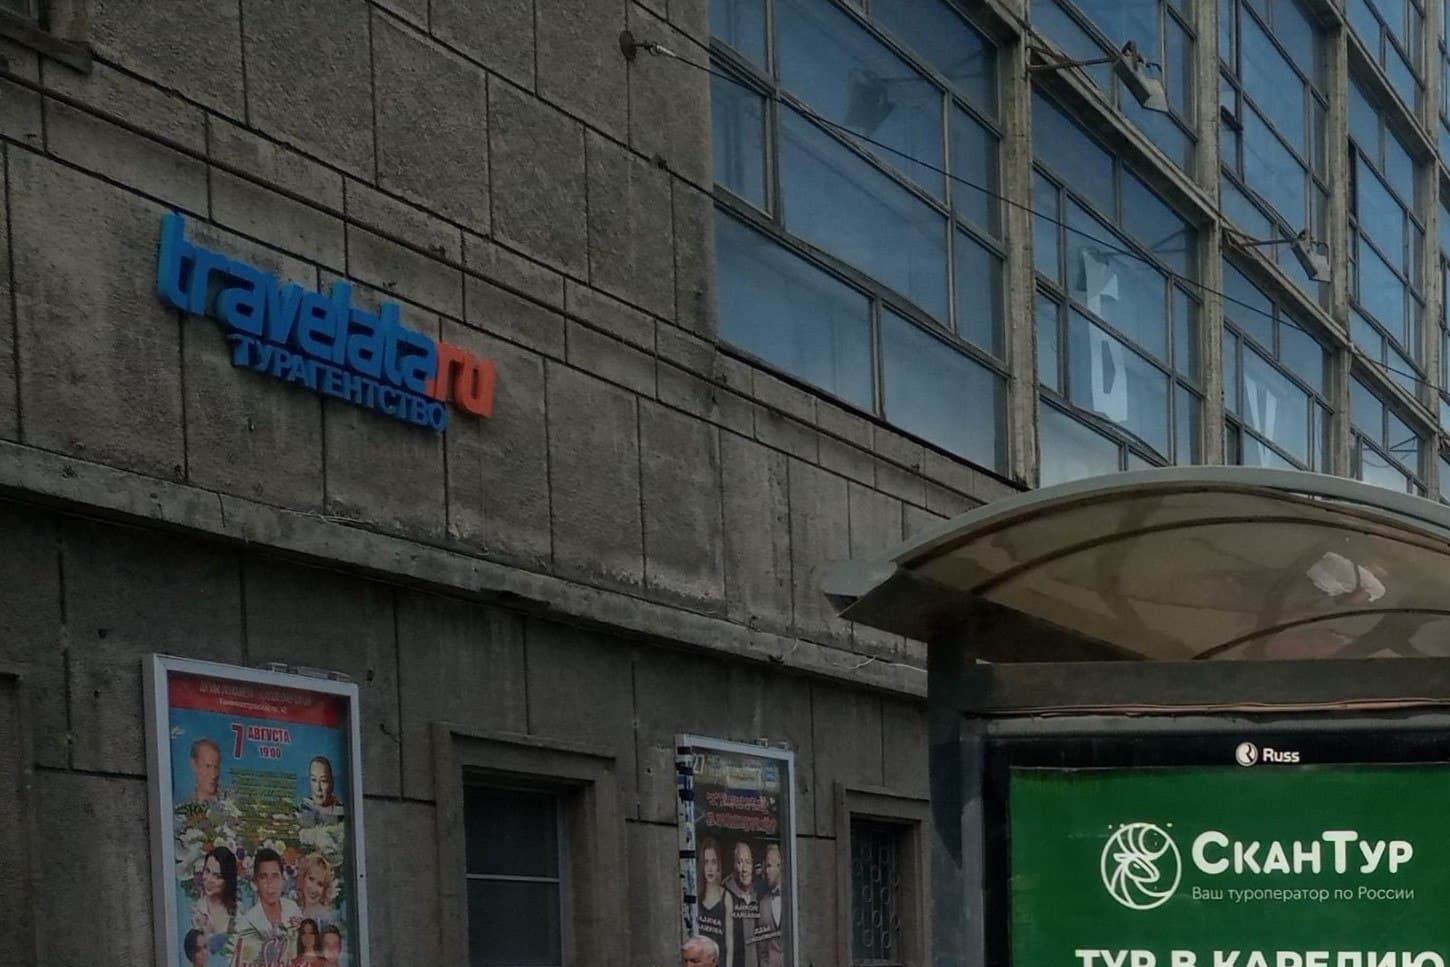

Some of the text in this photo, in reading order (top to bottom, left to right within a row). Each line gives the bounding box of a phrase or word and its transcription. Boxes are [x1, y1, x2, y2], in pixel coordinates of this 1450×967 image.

[228, 332, 448, 431] ТУРАГЕНТСТВО
[231, 722, 291, 760] 7 АВГУСТА
[1262, 747, 1300, 763] Russ
[1191, 830, 1414, 875] СканТур
[1192, 885, 1415, 903] Ваш туроператор по России
